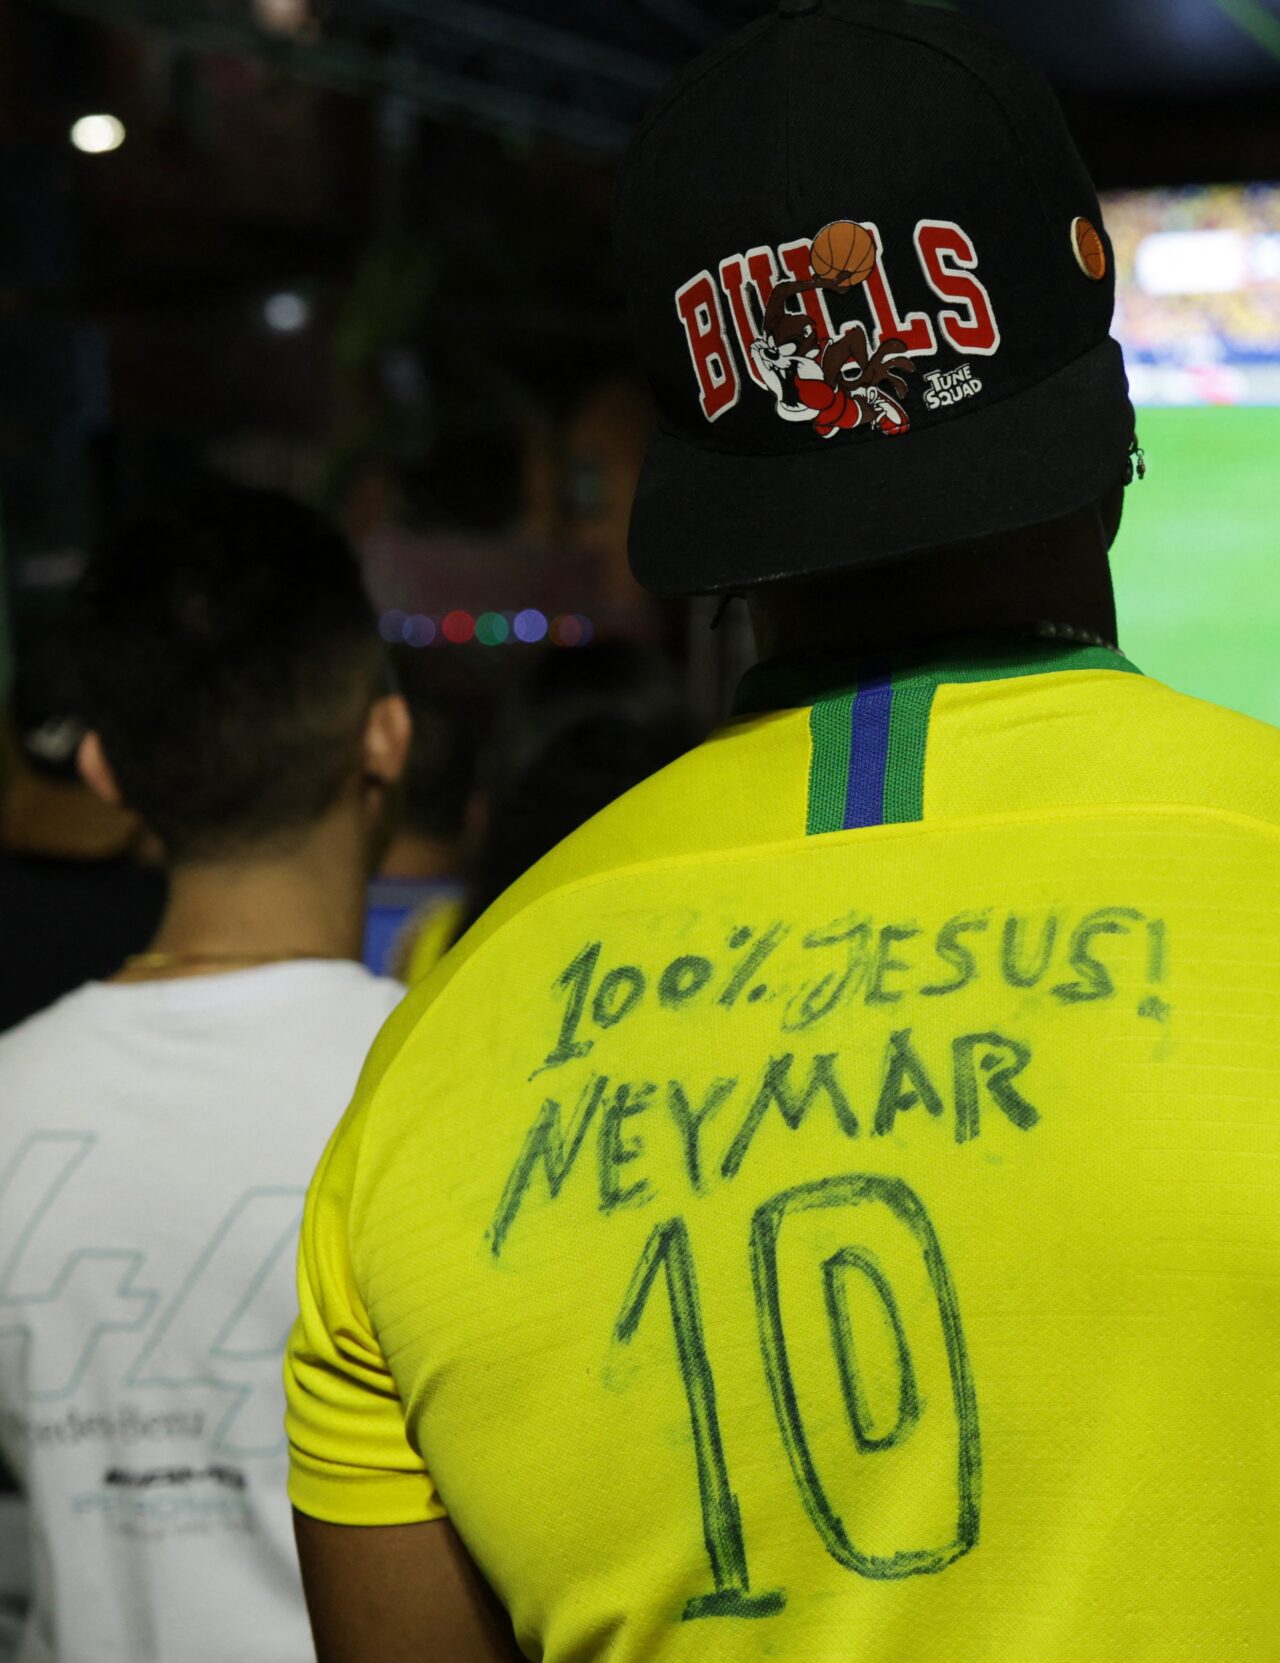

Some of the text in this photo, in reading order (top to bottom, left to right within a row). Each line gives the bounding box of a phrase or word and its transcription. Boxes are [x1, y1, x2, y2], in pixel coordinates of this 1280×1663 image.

[675, 218, 1001, 423] BULLS
[923, 363, 972, 392] TUNE
[923, 378, 983, 410] SQUAD
[529, 906, 1170, 1081] 100% JESUS!
[485, 1028, 1040, 1259] NEYMAR
[611, 1171, 983, 1622] 10
